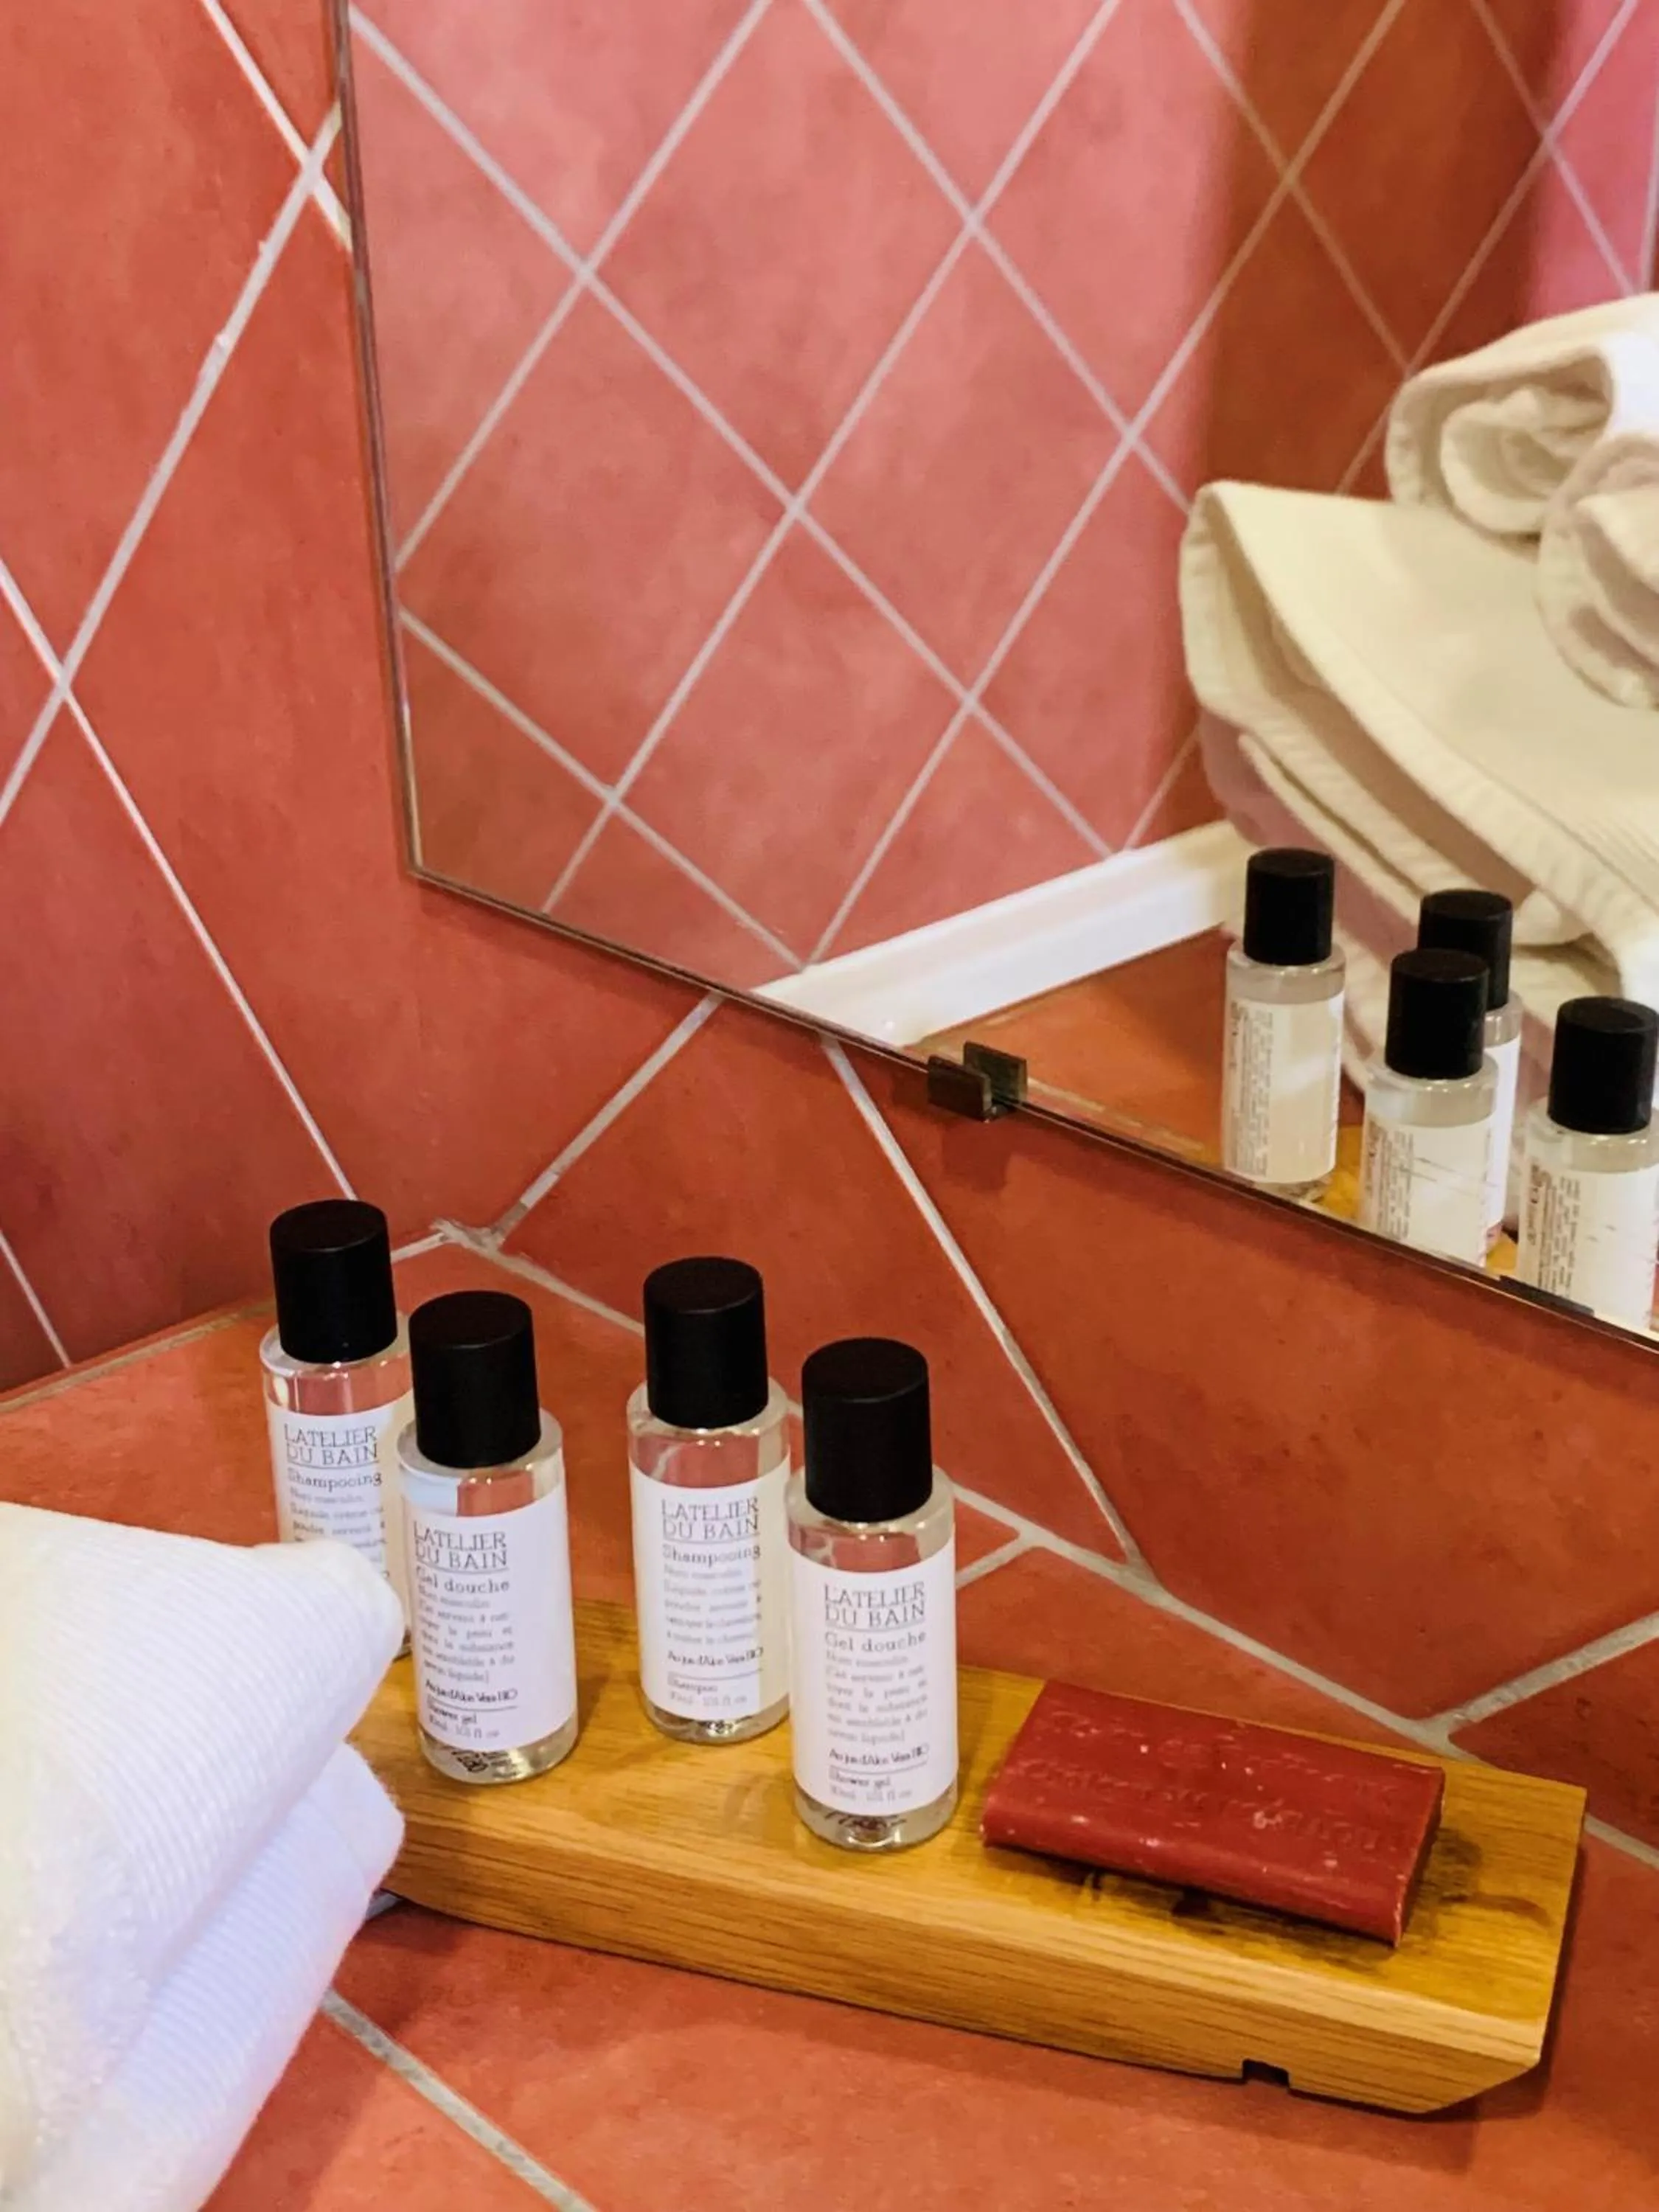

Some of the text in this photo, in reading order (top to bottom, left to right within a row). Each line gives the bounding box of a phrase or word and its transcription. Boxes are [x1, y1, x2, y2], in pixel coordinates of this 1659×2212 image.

[287, 1443, 378, 1466] DU BAIN
[288, 1467, 382, 1492] Shampooing
[664, 1514, 758, 1540] DU BAIN
[415, 1539, 439, 1565] DU
[448, 1549, 507, 1570] BAIN
[663, 1543, 761, 1568] Shampooing
[417, 1565, 510, 1593] Gel douche
[825, 1600, 925, 1627] DU BAIN
[824, 1631, 926, 1652] Gel douche
